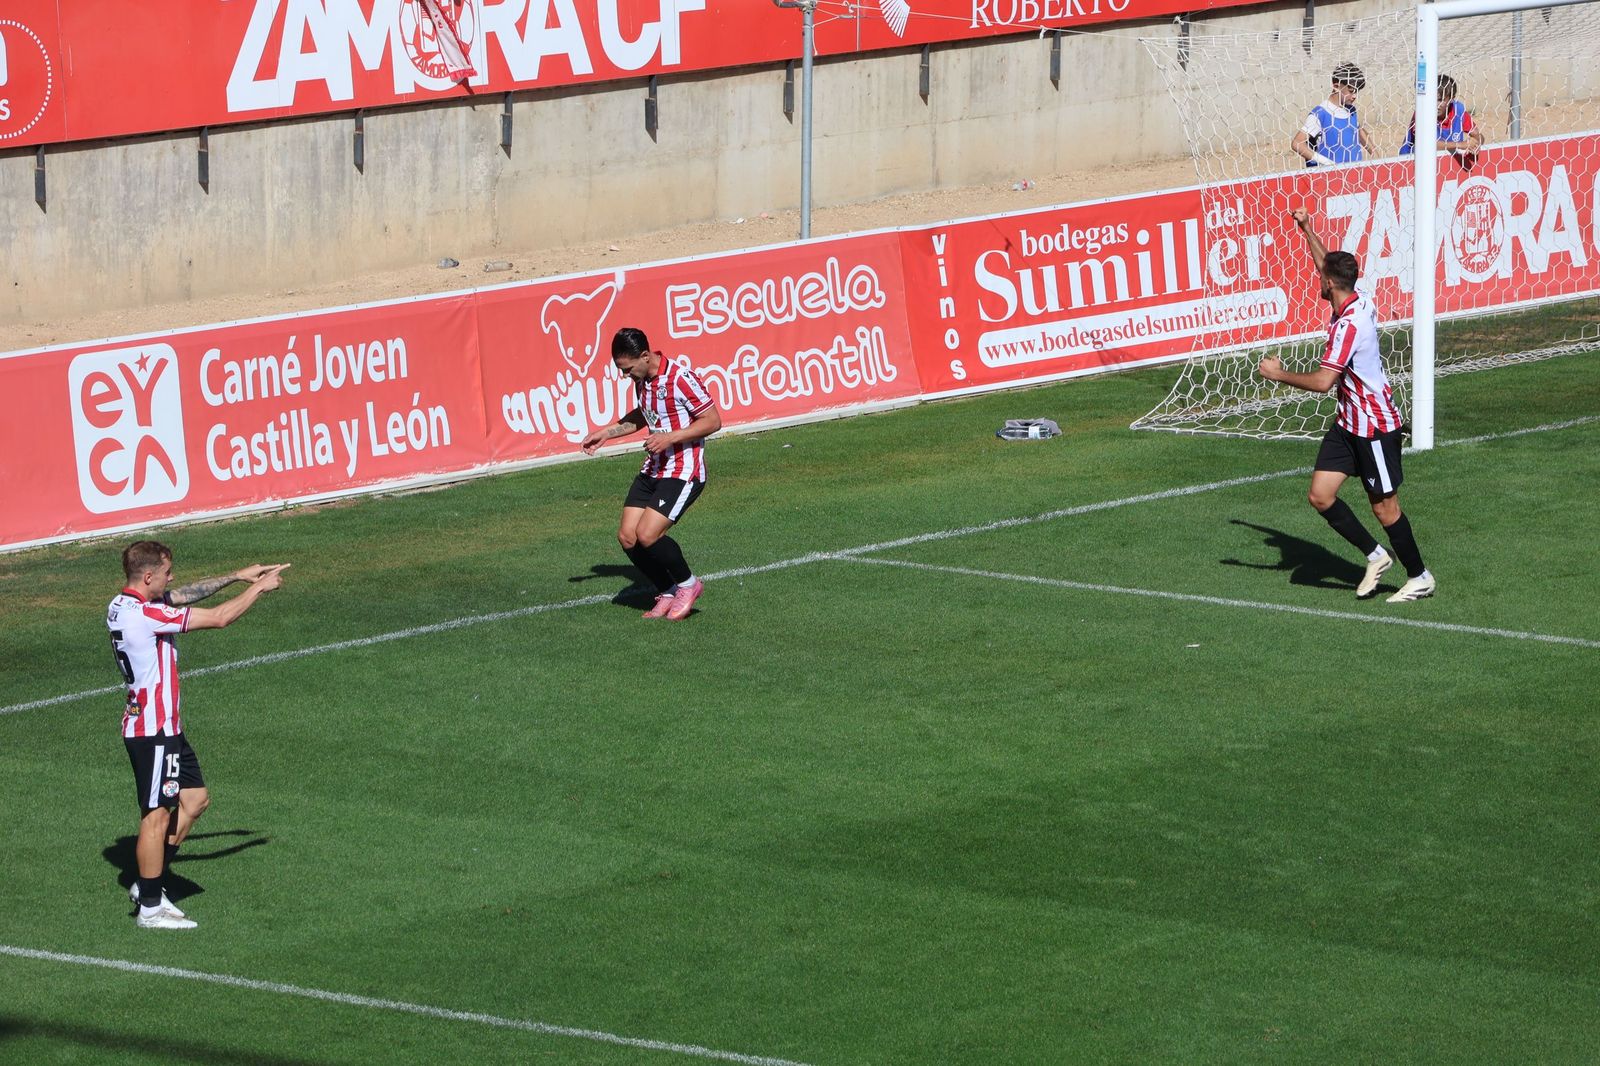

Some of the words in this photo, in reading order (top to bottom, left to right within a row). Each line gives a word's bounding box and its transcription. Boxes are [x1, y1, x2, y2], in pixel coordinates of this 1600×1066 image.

[226, 0, 594, 112] ZAMORA
[1019, 222, 1129, 257] bodegas
[1206, 198, 1245, 229] del
[665, 256, 887, 340] Escuela
[973, 217, 1274, 323] Sumiller
[984, 301, 1278, 361] www.bodegasdelsumiller.com
[199, 335, 302, 407] Carné
[309, 333, 409, 394] Joven
[205, 408, 335, 482] Castilla
[338, 418, 360, 479] y
[366, 392, 452, 458] León
[501, 374, 639, 444] cangur
[165, 753, 180, 778] 15
